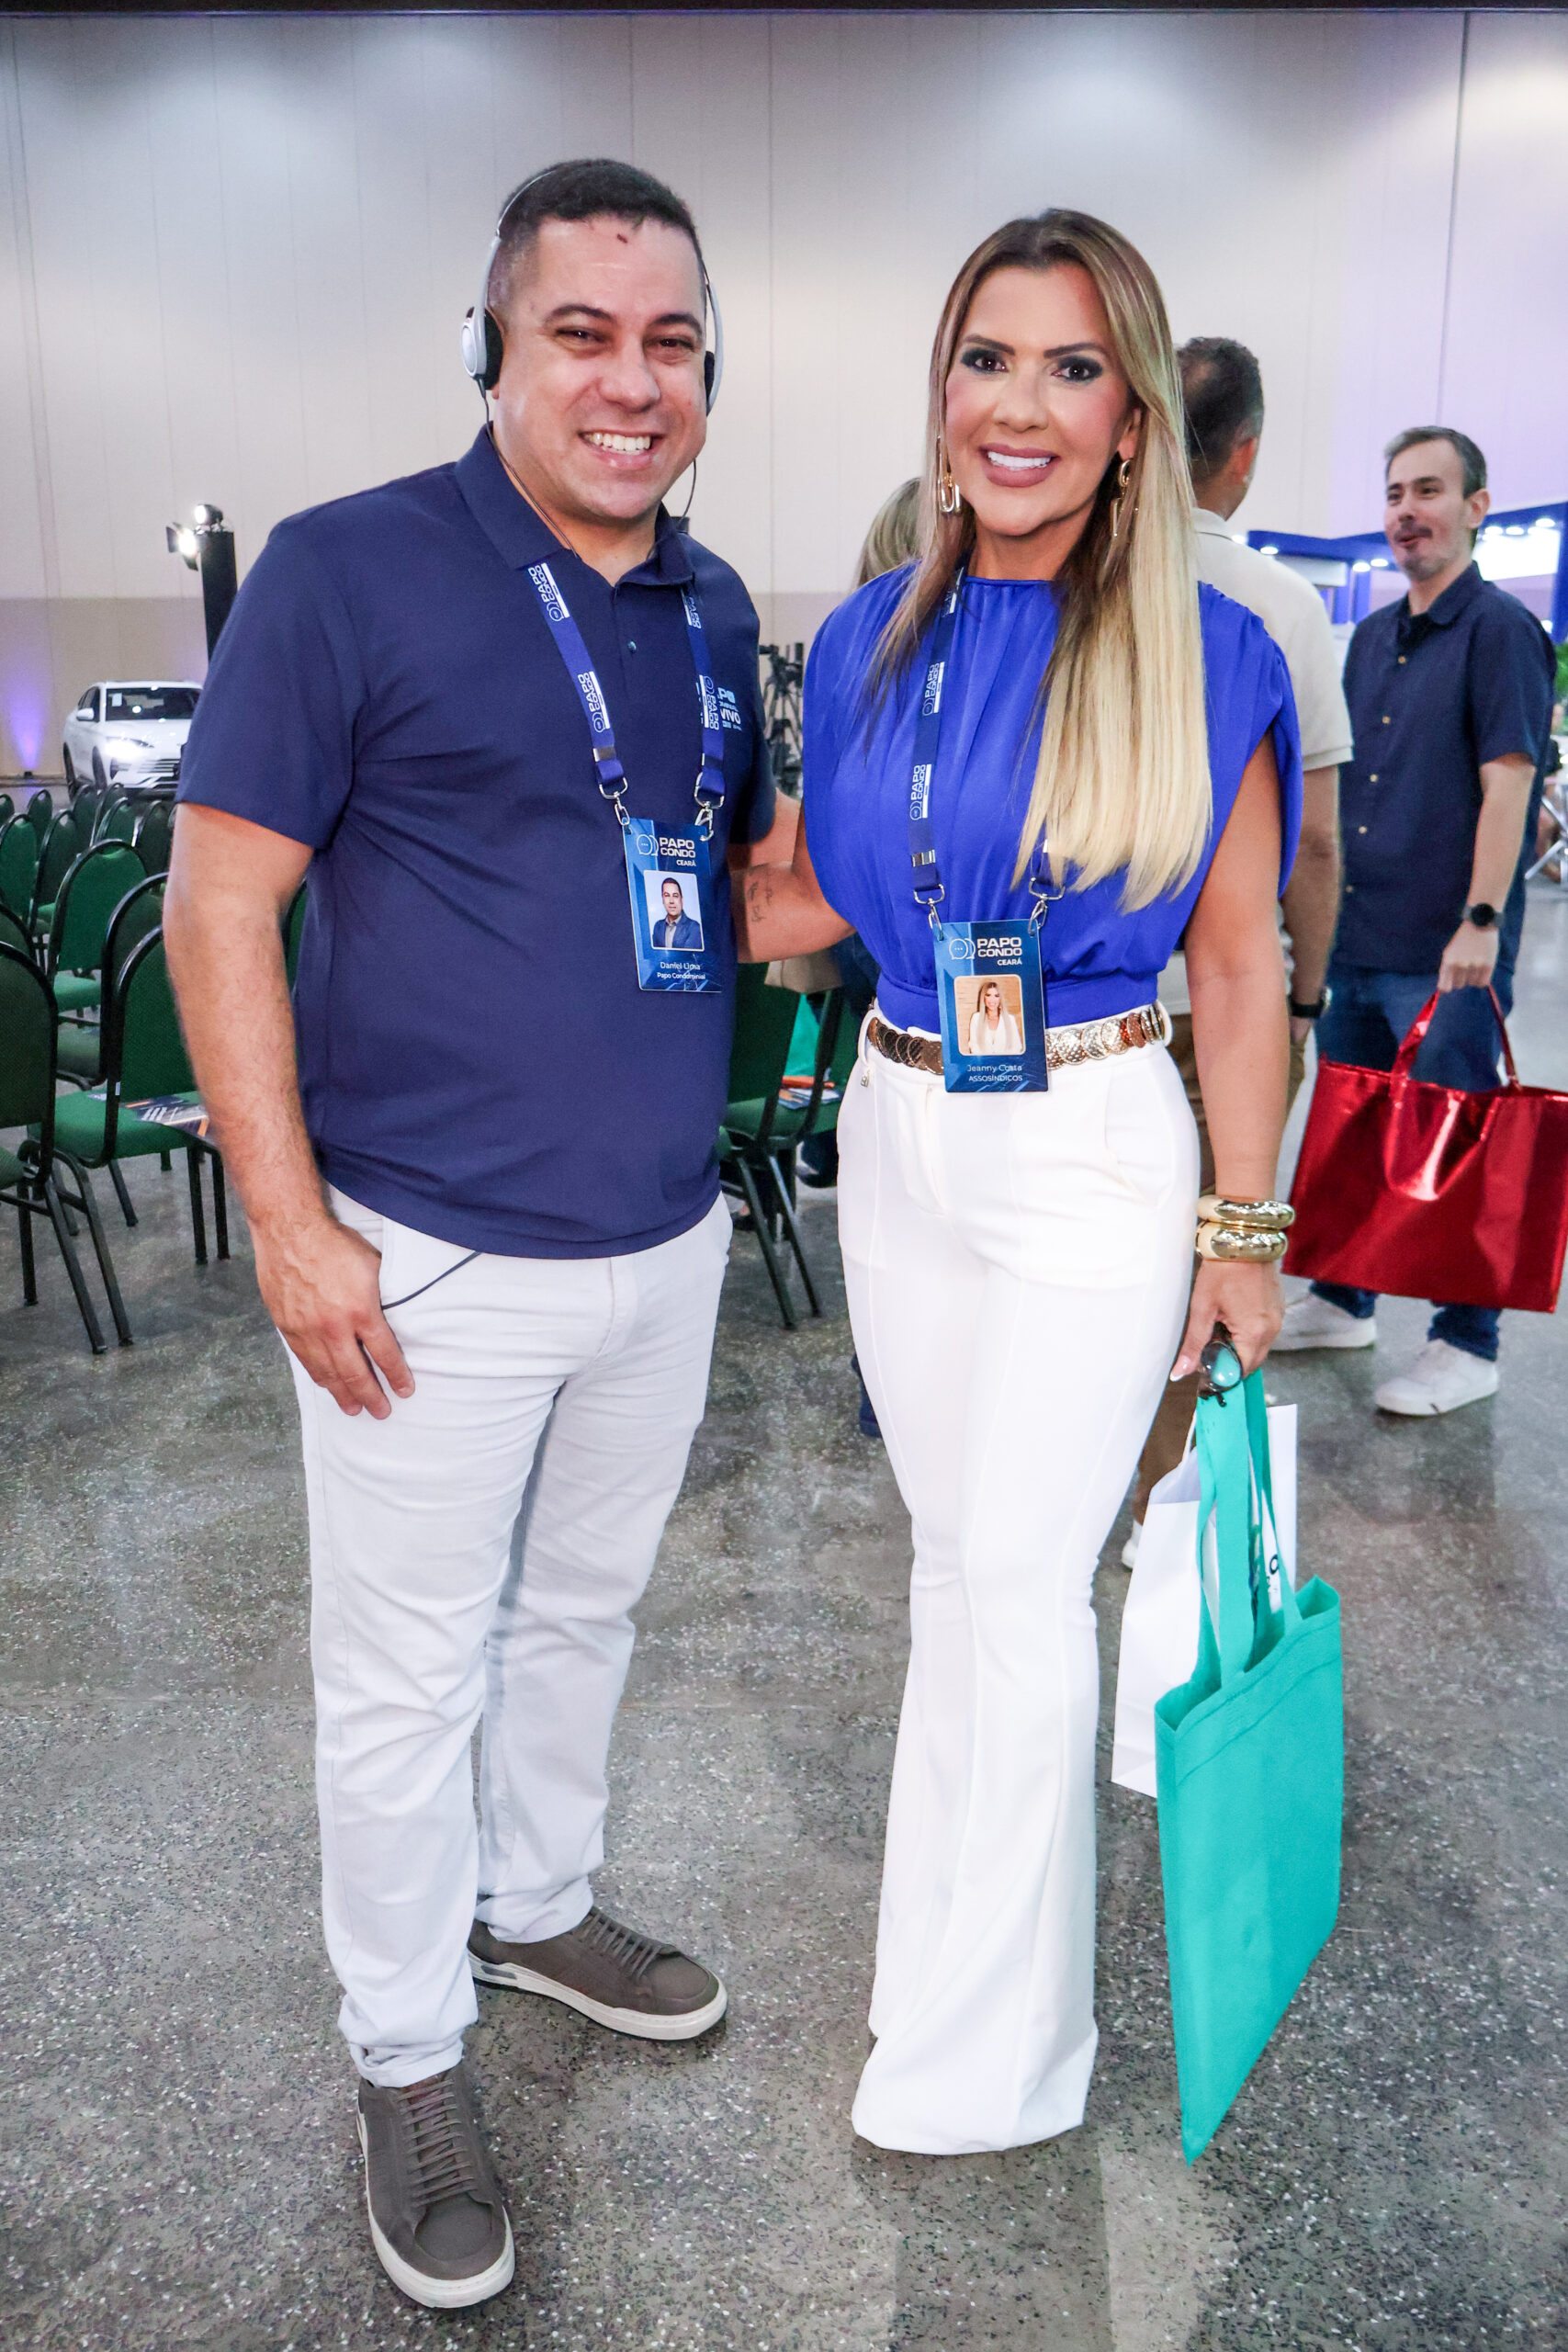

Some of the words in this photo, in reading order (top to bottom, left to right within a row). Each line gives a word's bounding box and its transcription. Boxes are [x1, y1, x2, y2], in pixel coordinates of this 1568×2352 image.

[528, 567, 550, 603] PAPO
[535, 565, 555, 601] CONDO
[578, 673, 596, 712] PAPO
[583, 672, 600, 710] CONDO
[710, 695, 719, 730] PAPO
[720, 708, 741, 724] VIVO
[911, 765, 920, 800] PAPO
[917, 763, 926, 799] CONDO
[659, 837, 695, 850] PAPO
[660, 847, 696, 858] CONDO
[976, 936, 1022, 948] PAPO
[977, 947, 1022, 957] CONDO
[997, 957, 1022, 966] CEARÁ
